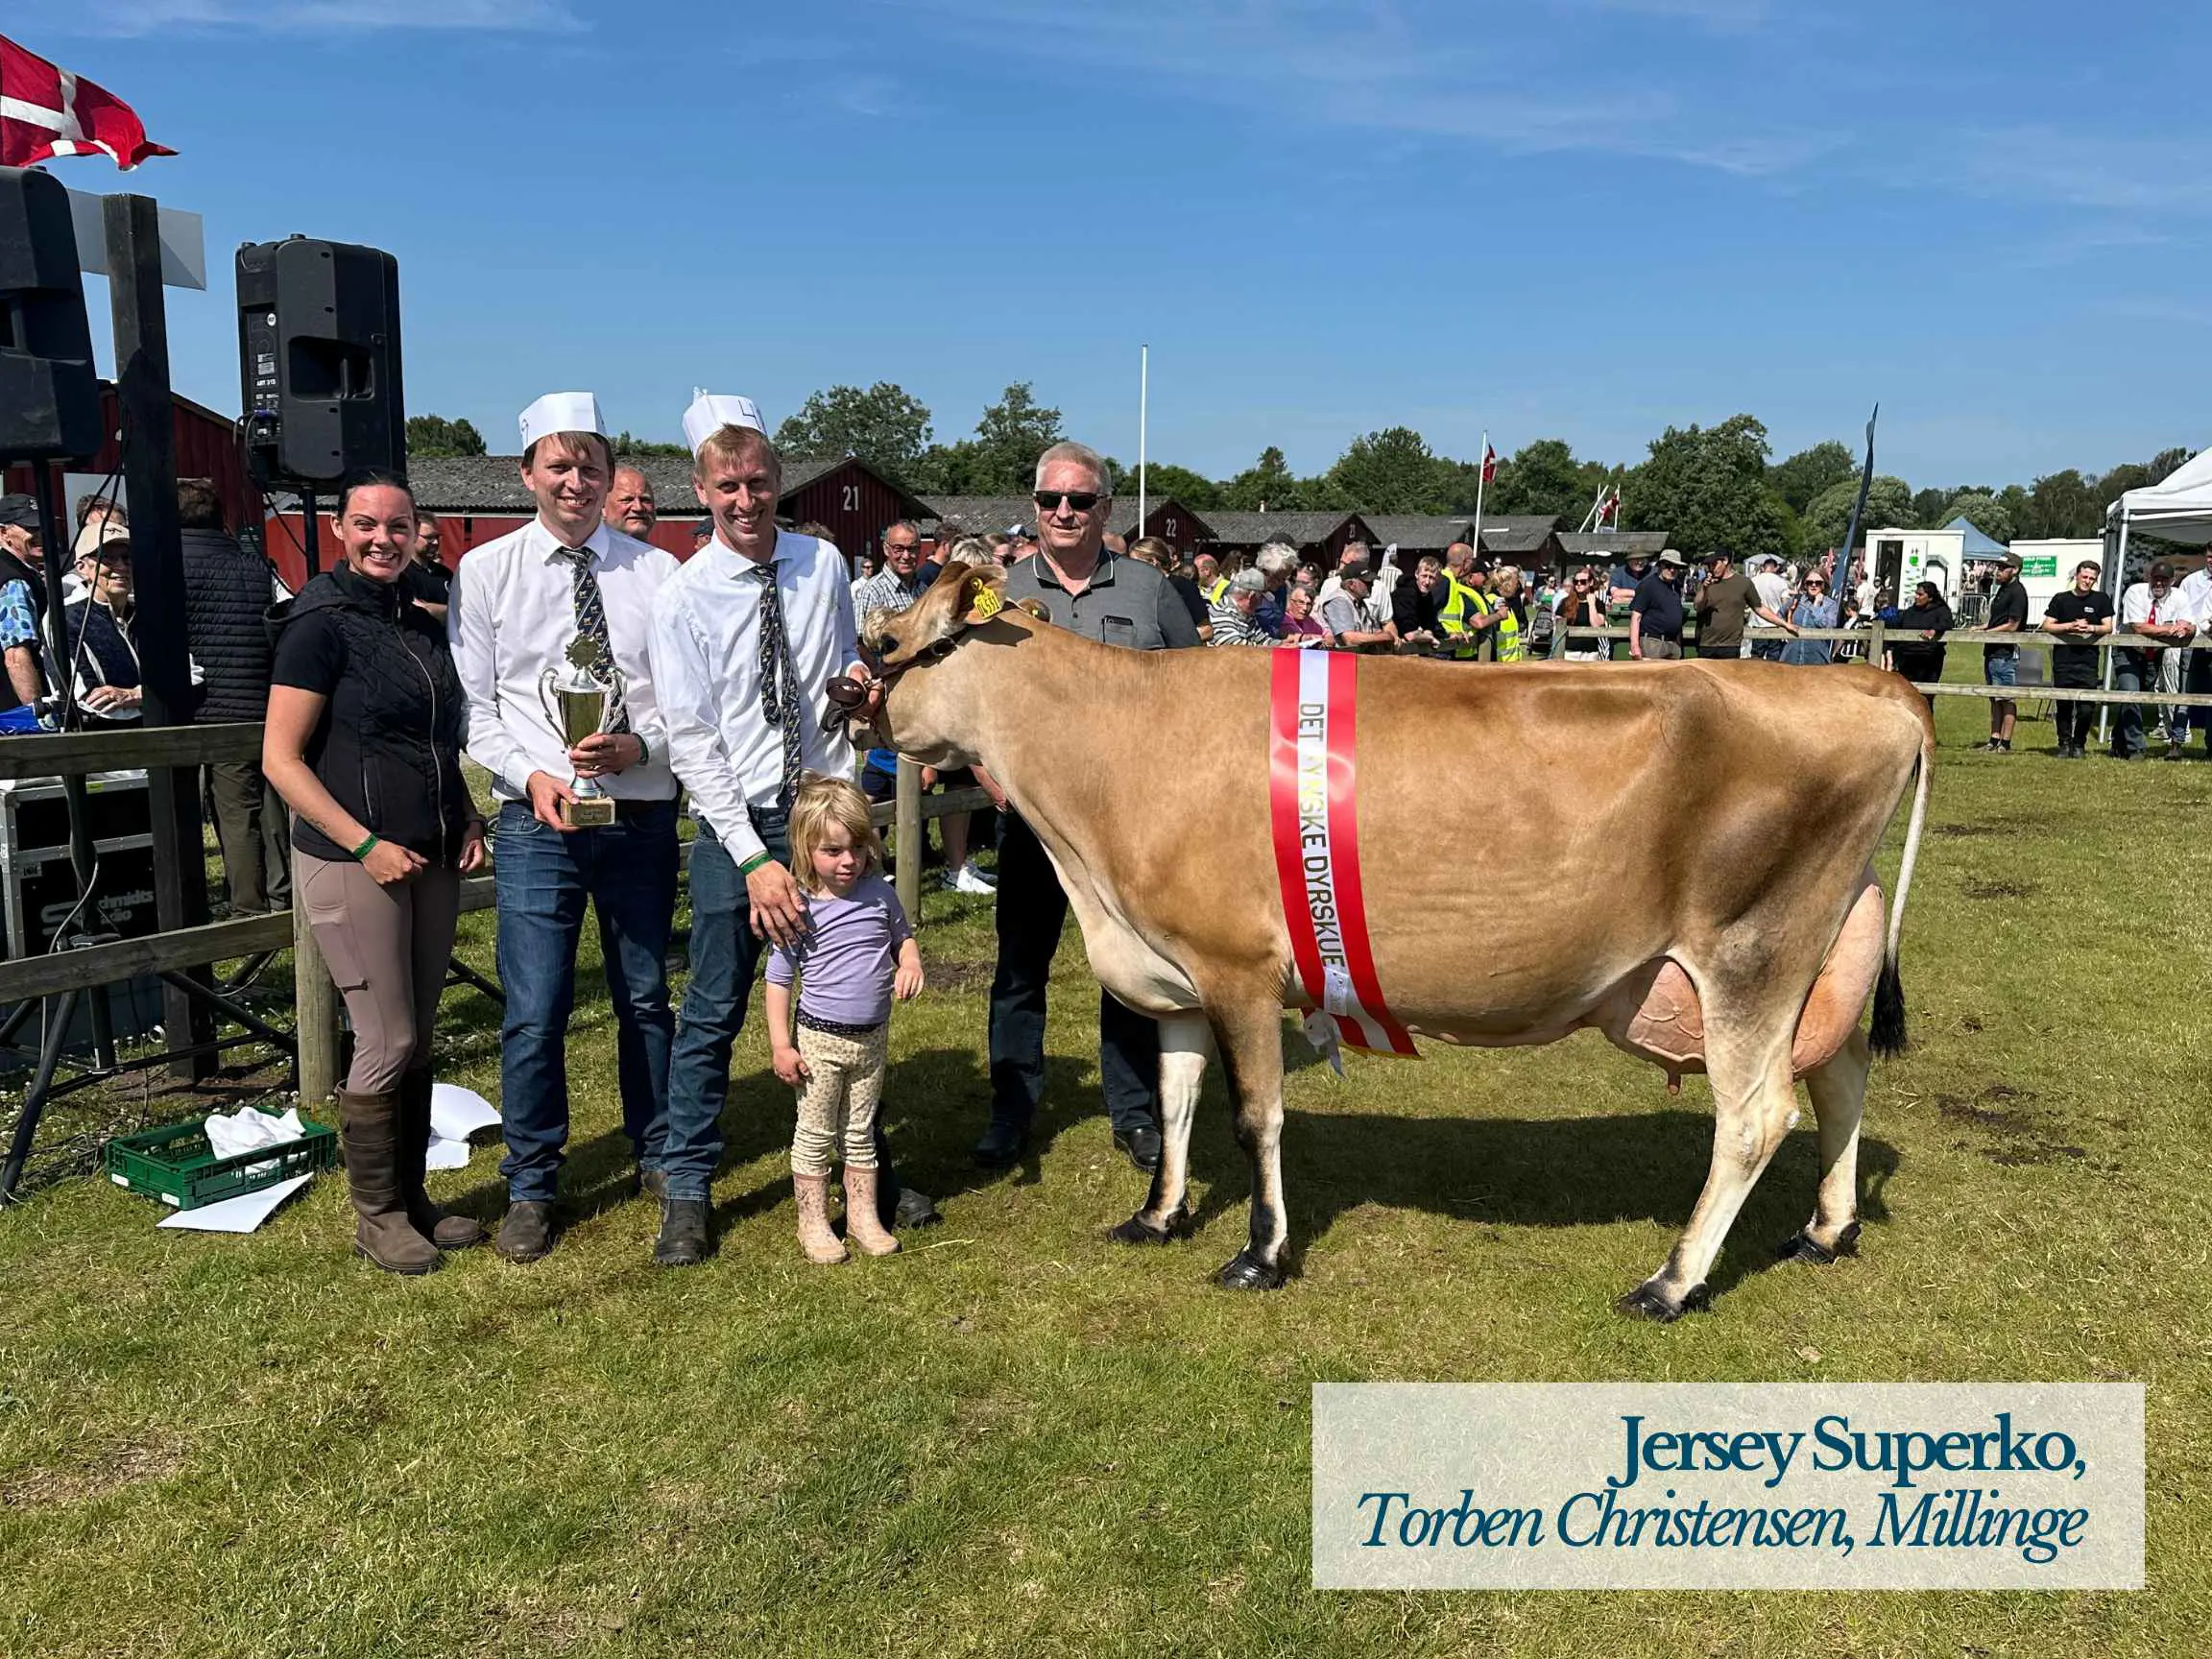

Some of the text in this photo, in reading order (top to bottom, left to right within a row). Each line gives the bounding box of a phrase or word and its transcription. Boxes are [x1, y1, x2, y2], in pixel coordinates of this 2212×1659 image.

[843, 486, 859, 511] 21
[1166, 518, 1177, 537] 22
[1298, 704, 1325, 742] DET
[1304, 855, 1346, 968] DYRSKUE
